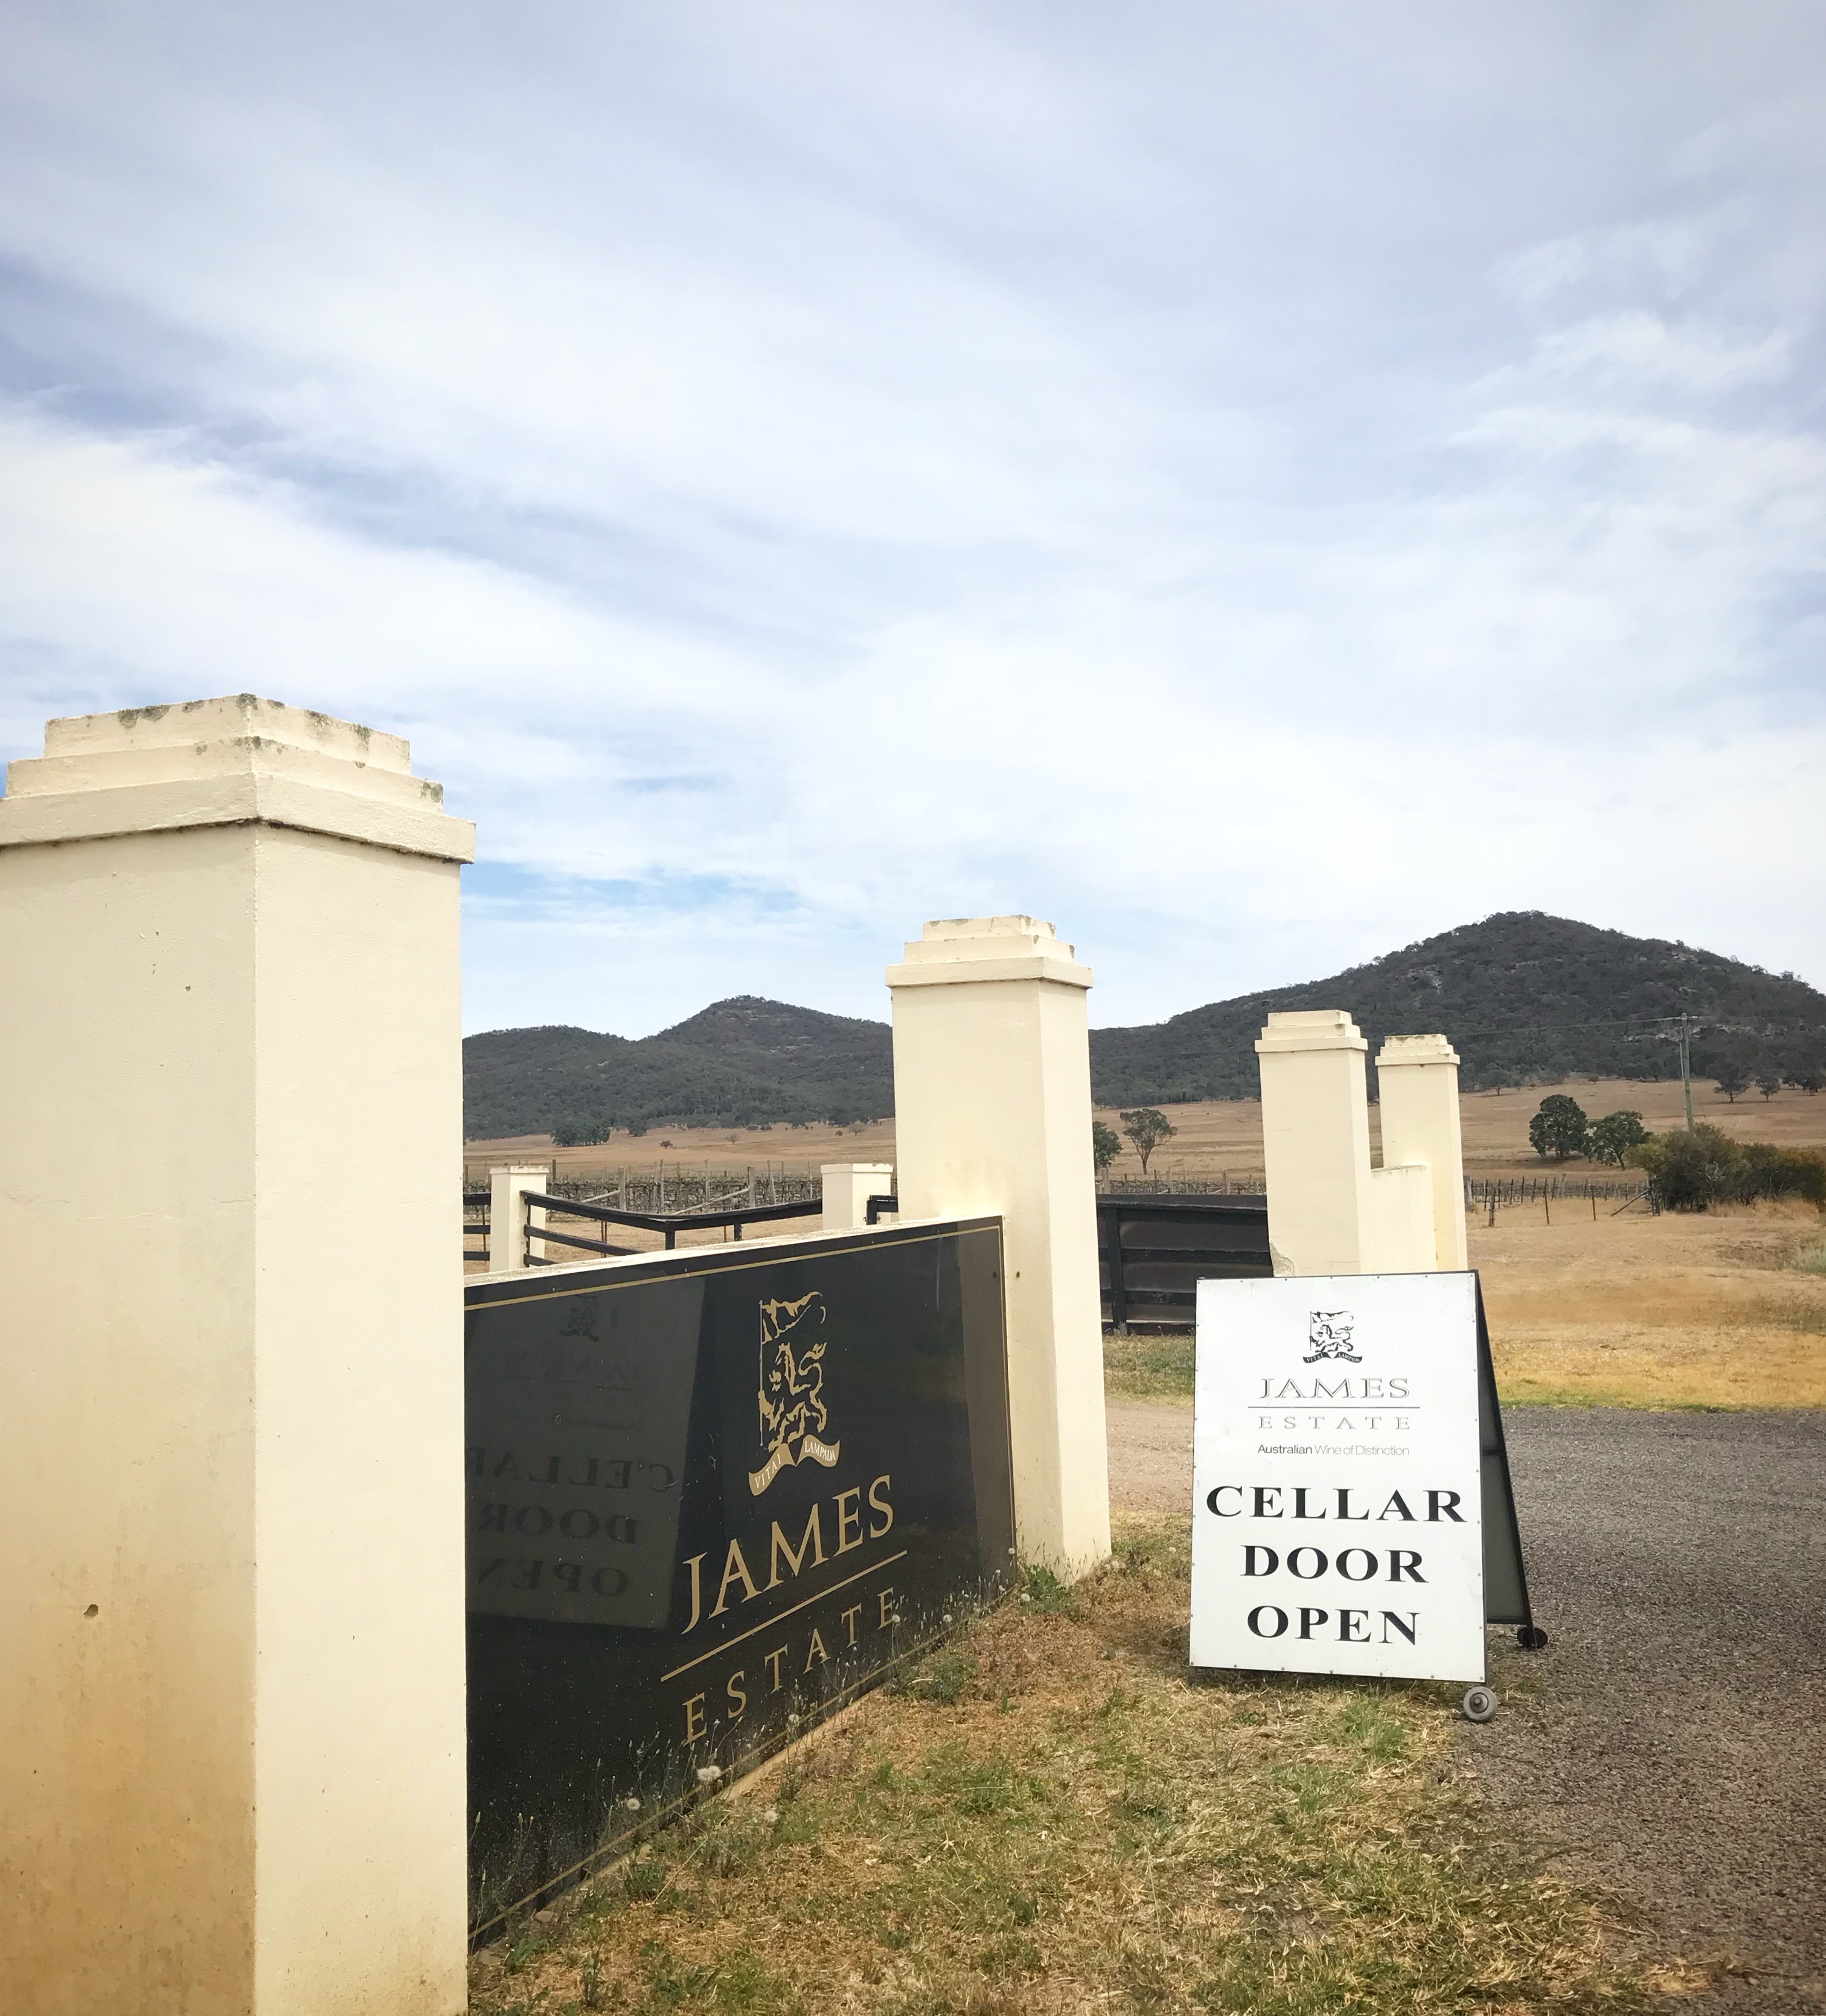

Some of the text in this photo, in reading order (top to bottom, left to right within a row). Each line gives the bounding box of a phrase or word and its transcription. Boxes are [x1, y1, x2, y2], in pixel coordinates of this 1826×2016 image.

[1258, 1378, 1410, 1398] JAMES
[1258, 1416, 1410, 1430] ESTATE
[755, 1441, 836, 1488] VITAI LAMPADA
[1258, 1444, 1409, 1455] Australian Wine of Distinction
[1206, 1485, 1467, 1523] CELLAR
[681, 1474, 894, 1634] JAMES
[1240, 1544, 1429, 1583] DOOR
[1247, 1605, 1420, 1645] OPEN
[681, 1587, 895, 1747] ESTATE
